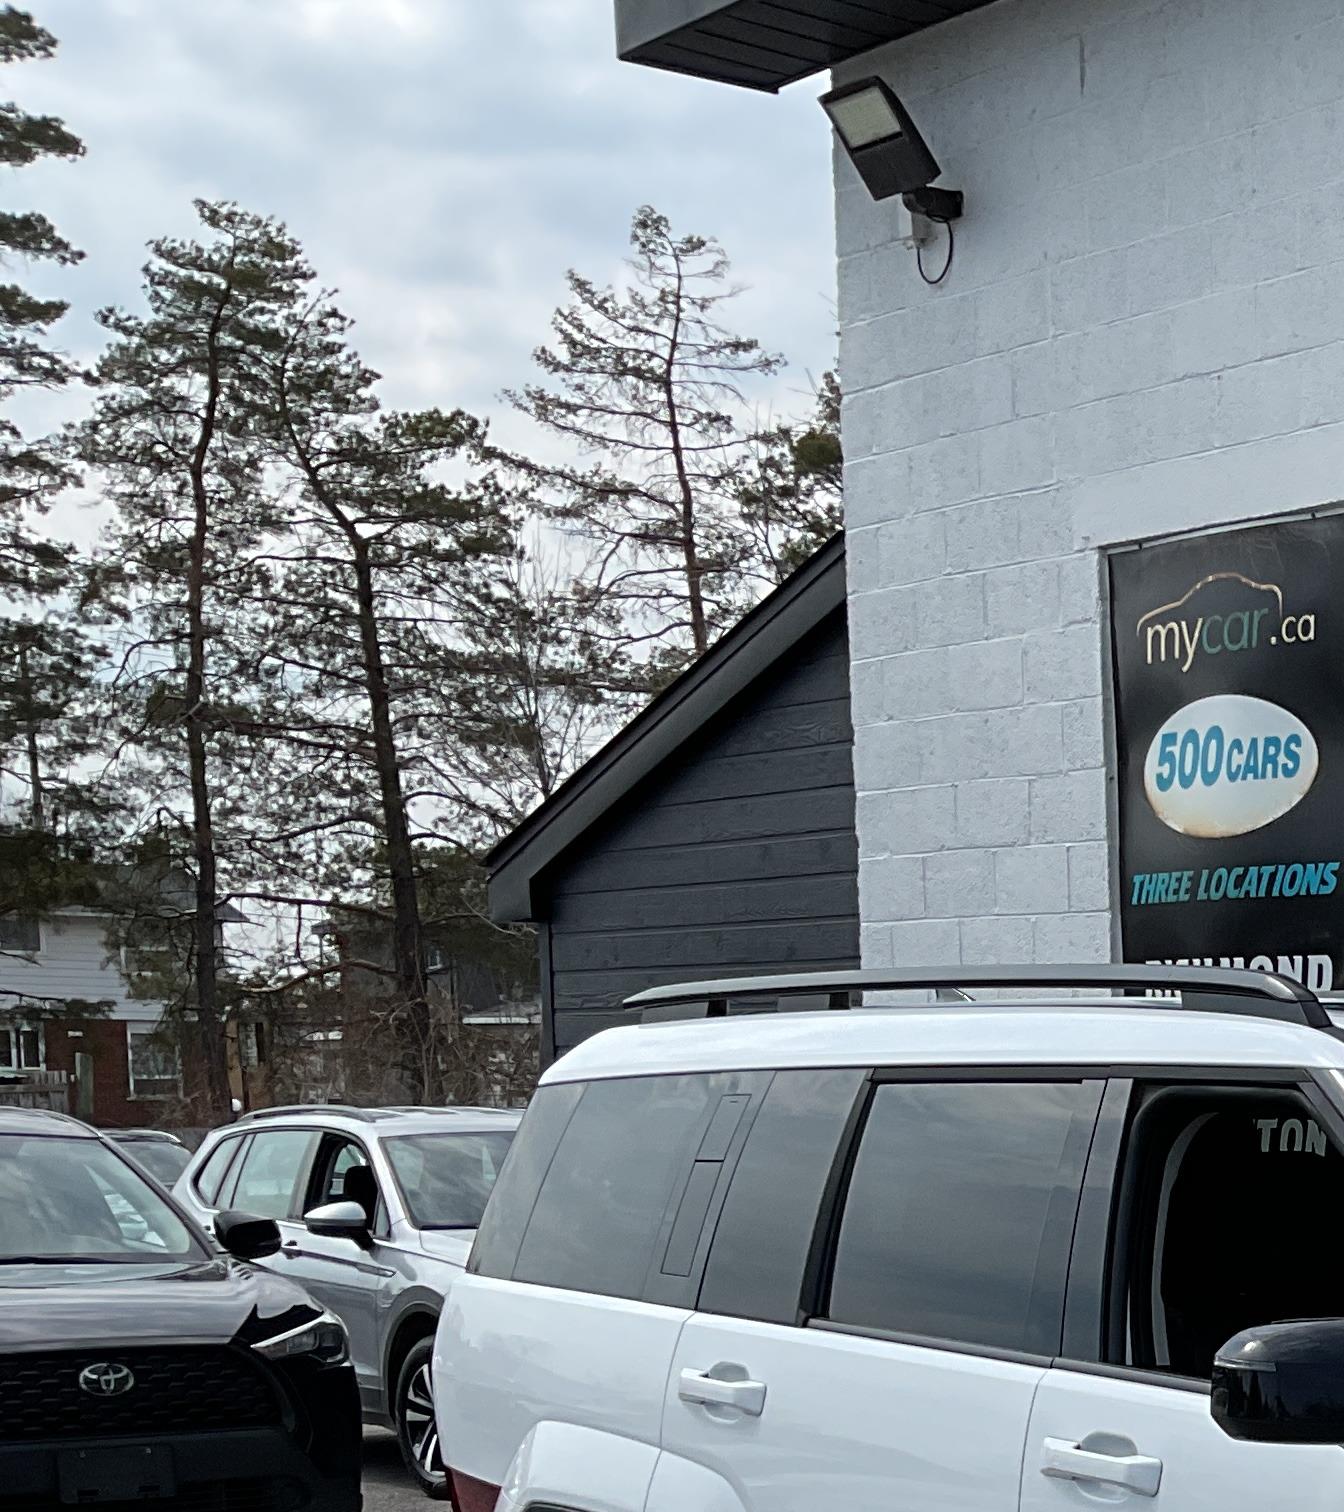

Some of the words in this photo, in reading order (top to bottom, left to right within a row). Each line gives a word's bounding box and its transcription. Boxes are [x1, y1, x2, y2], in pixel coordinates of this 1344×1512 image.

[1145, 606, 1316, 673] mycar.ca
[1131, 869, 1195, 906] THREE
[1196, 861, 1341, 902] LOCATIONS
[1252, 1117, 1328, 1158] TON
